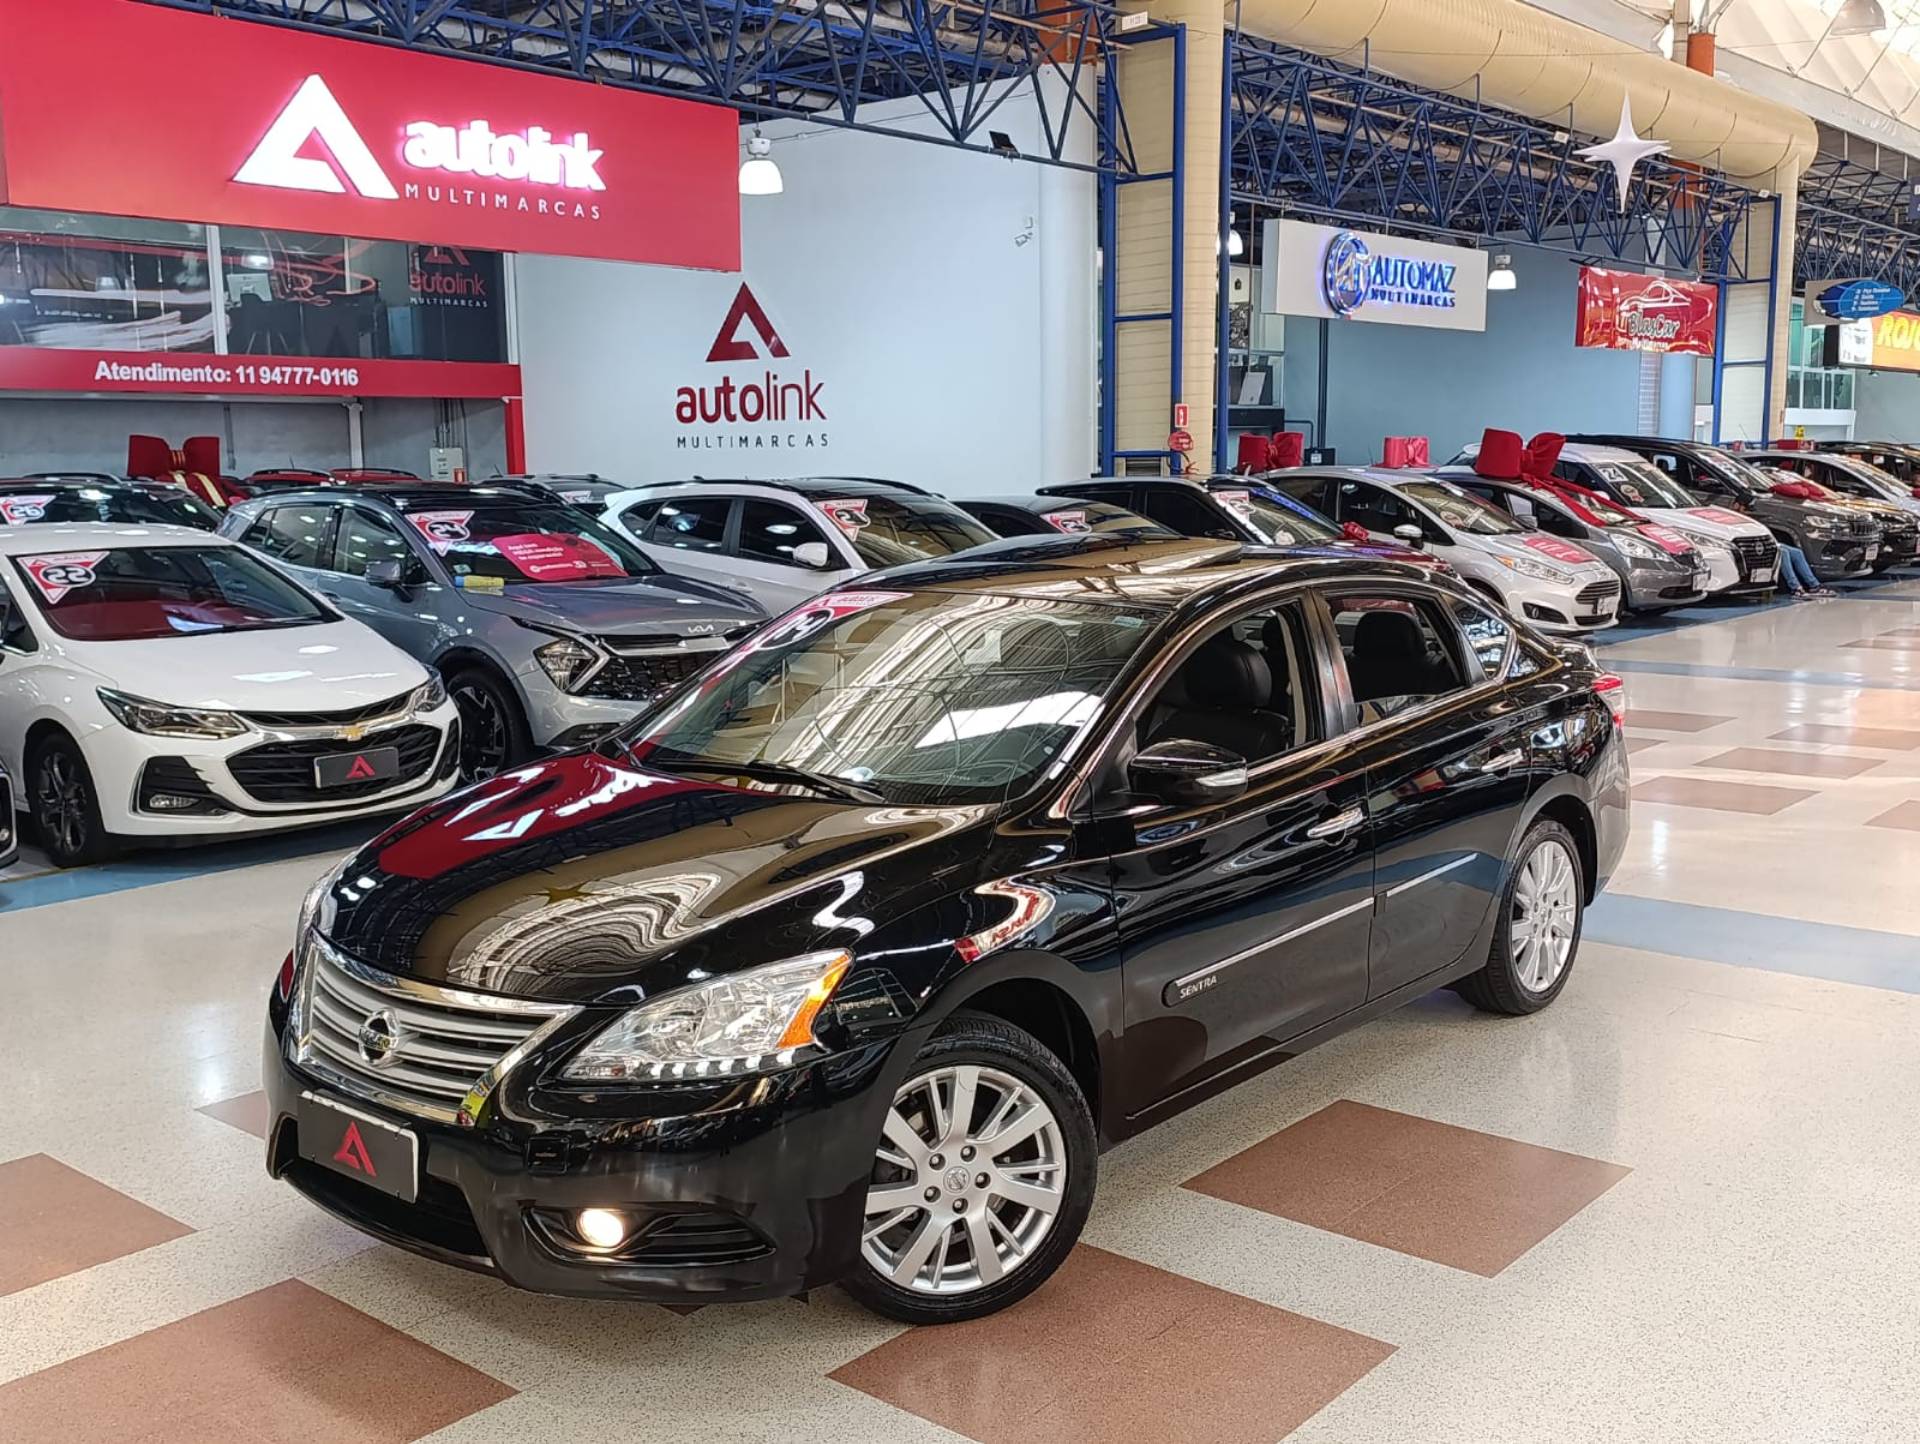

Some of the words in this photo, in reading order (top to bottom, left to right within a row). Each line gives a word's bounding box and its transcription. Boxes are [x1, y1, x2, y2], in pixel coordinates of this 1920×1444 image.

[403, 120, 607, 191] autolink
[405, 183, 600, 220] MULTIMARCAS
[1371, 254, 1457, 293] AUTOMAZ
[409, 297, 488, 308] MULTIMARCAS
[1371, 288, 1456, 307] MULTIMARCAS
[95, 361, 231, 383] Atendimento:
[235, 366, 256, 384] 11
[259, 366, 359, 386] 94777-0116
[675, 369, 827, 424] autolink
[677, 433, 829, 448] MULTIMARCAS
[430, 523, 467, 538] 24
[46, 567, 88, 583] 22
[1179, 975, 1217, 999] SENTRA
